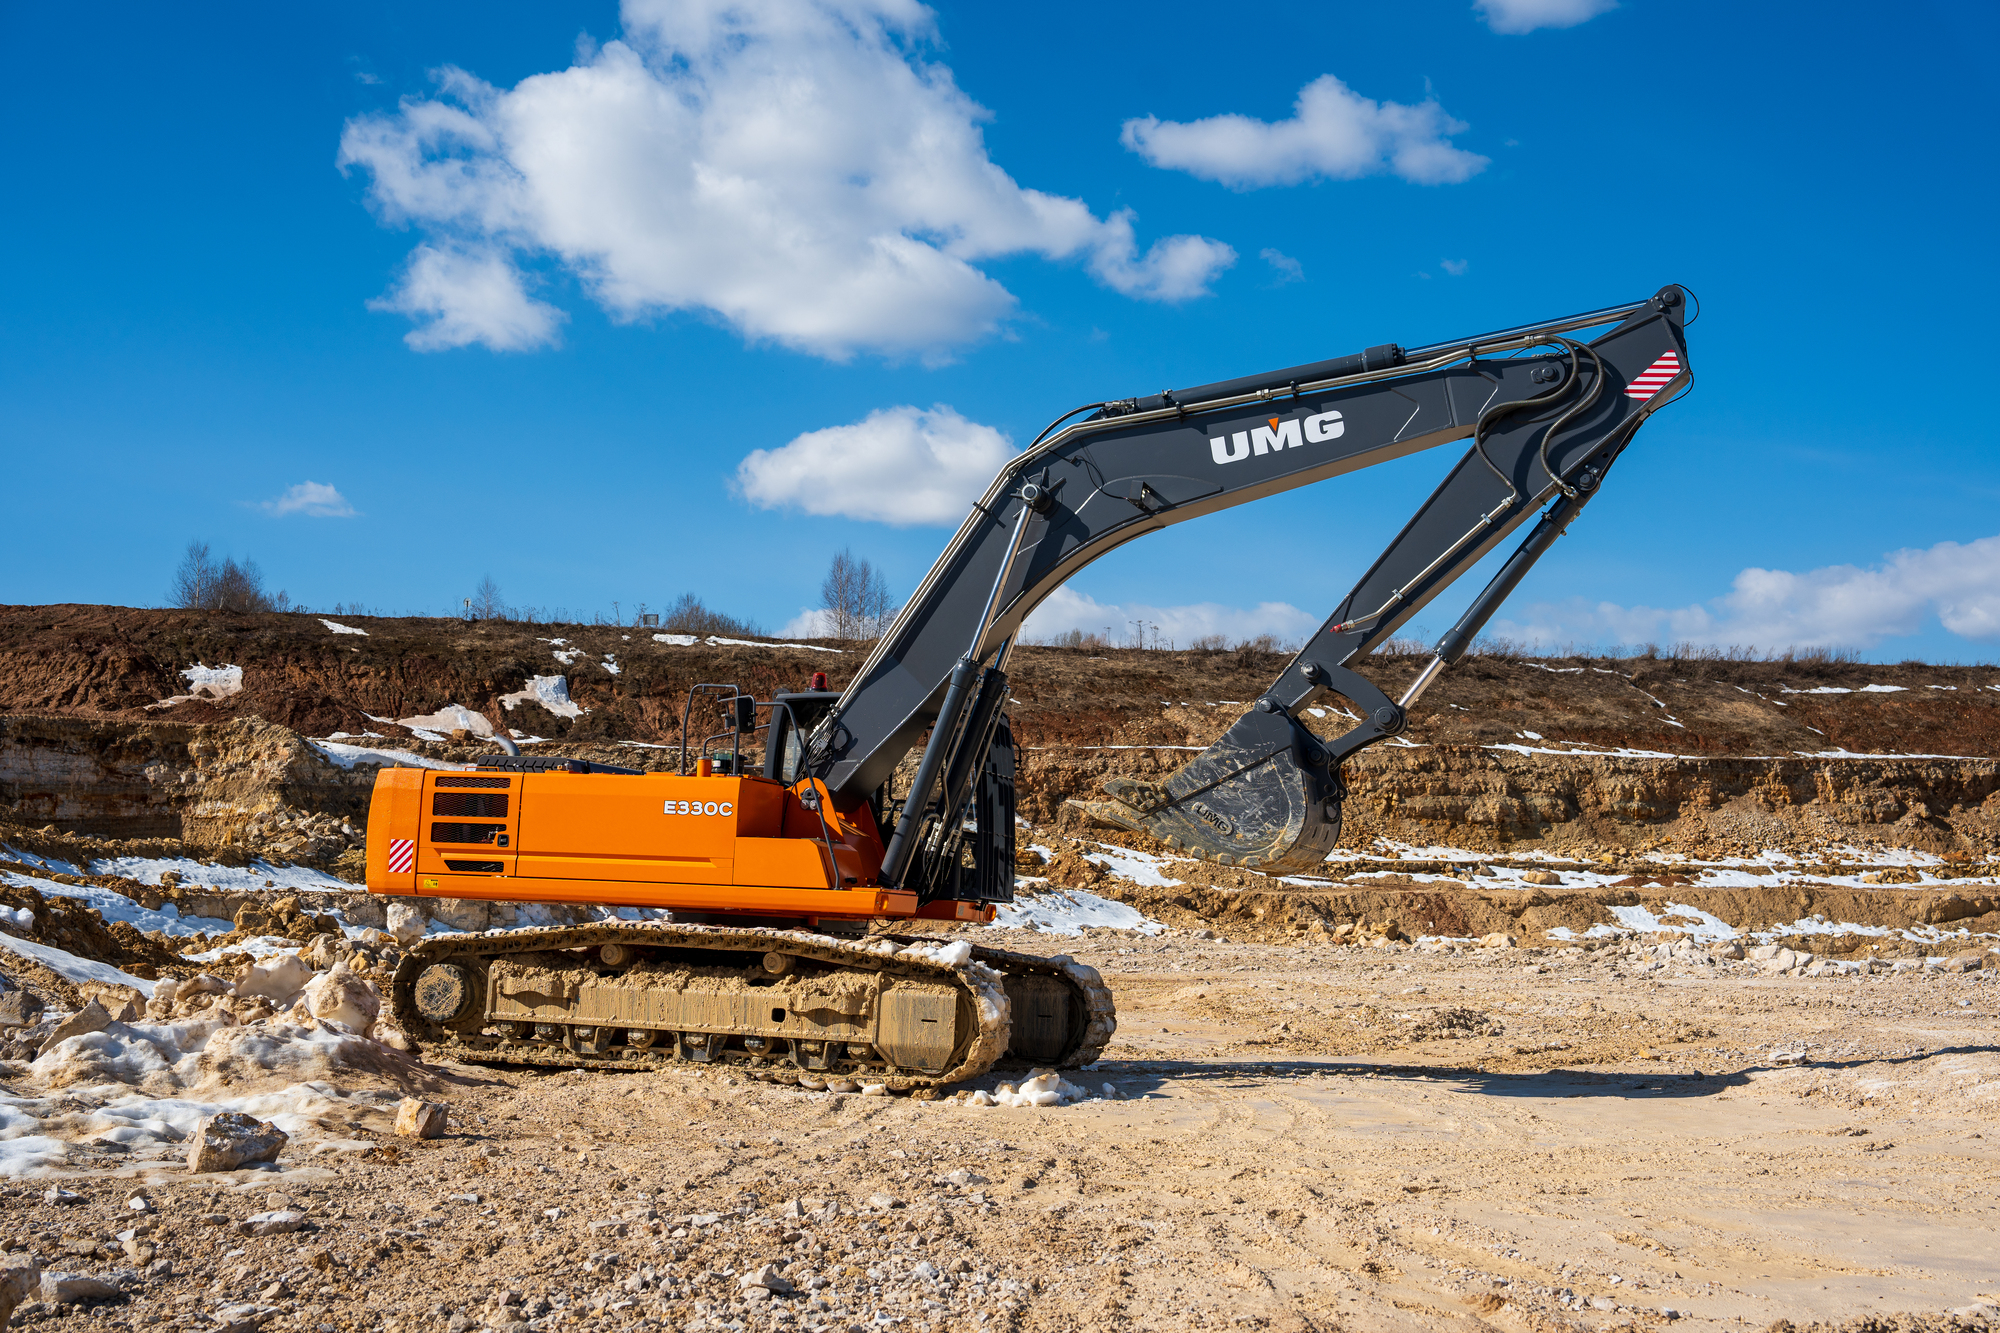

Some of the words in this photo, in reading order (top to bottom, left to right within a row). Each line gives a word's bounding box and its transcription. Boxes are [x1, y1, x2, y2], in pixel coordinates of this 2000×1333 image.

[1209, 410, 1345, 465] UMG
[663, 800, 734, 817] E330C
[1196, 805, 1229, 831] UMG
